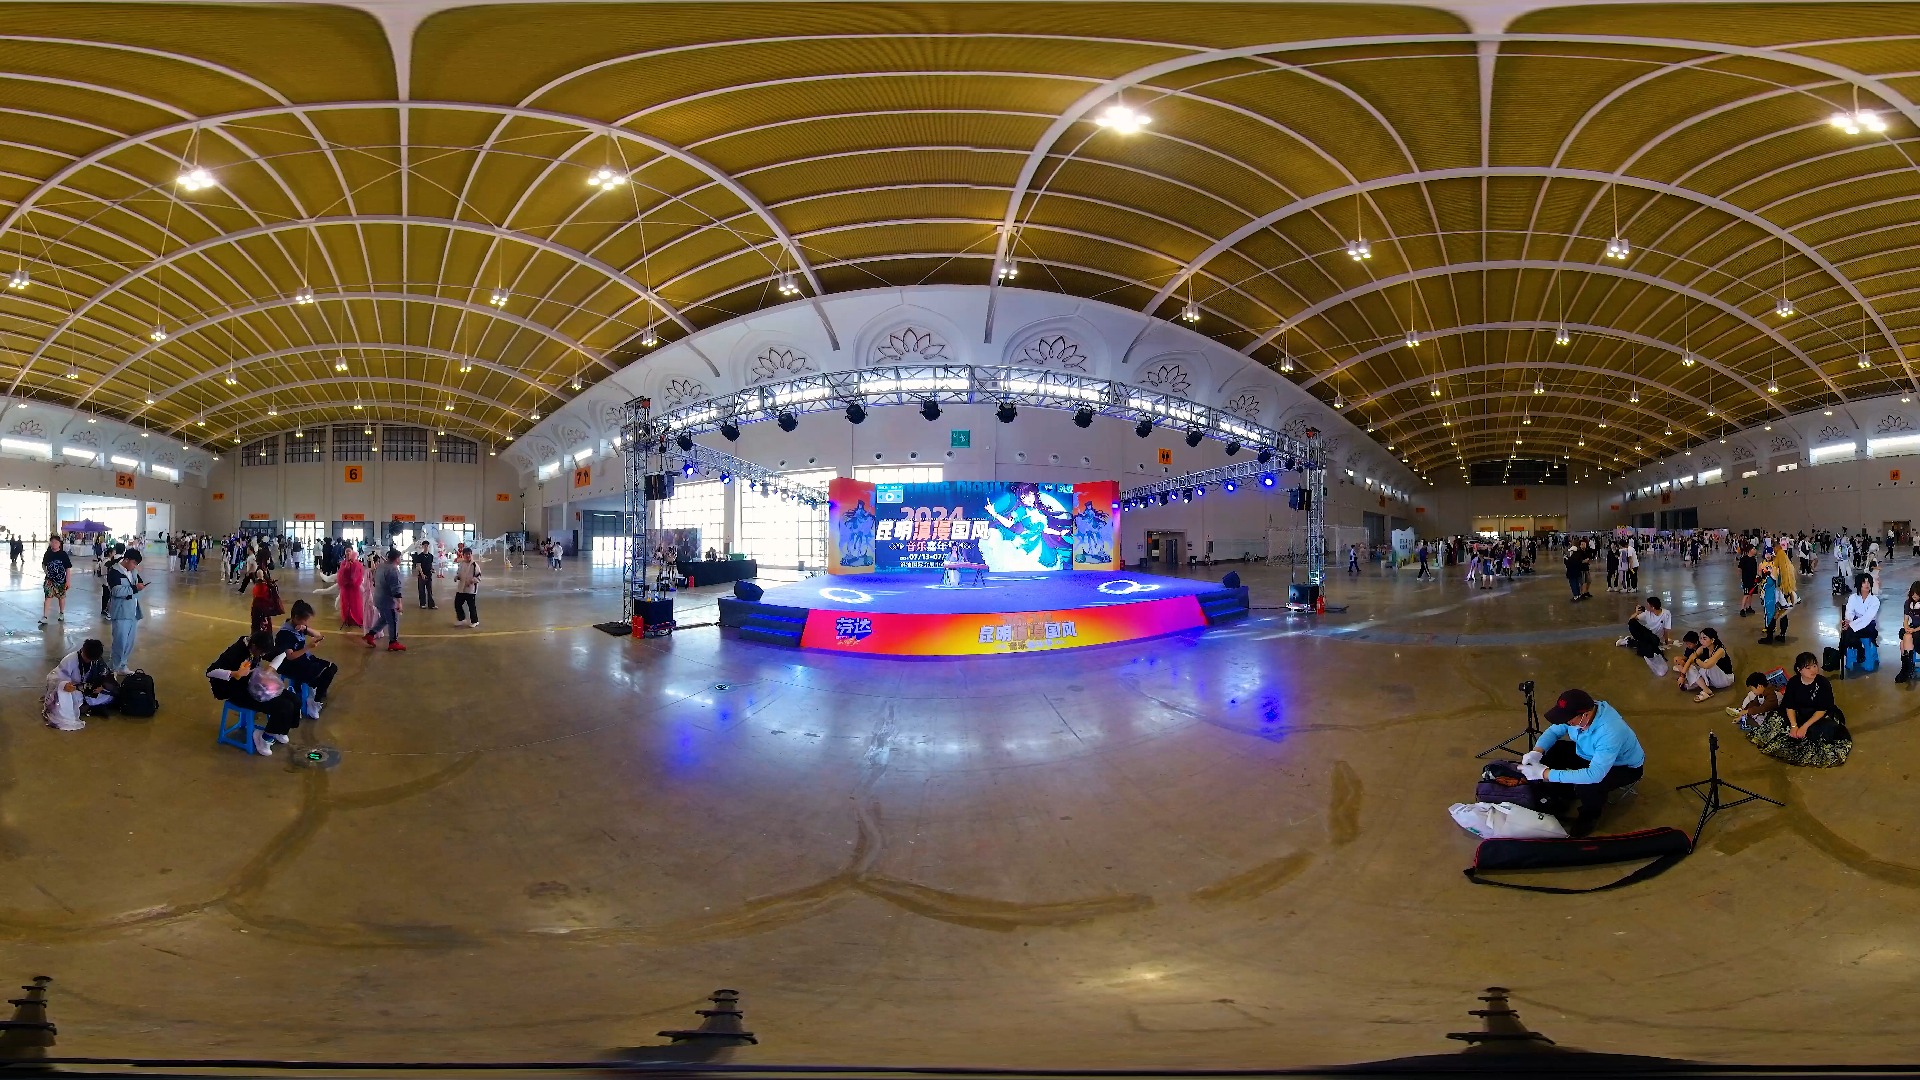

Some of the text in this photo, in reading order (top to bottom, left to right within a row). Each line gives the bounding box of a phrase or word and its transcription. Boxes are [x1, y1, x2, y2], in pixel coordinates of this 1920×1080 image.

[350, 469, 357, 480] 6
[119, 475, 126, 486] 5
[901, 507, 963, 521] 2024
[906, 541, 953, 552] 音乐嘉年
[836, 617, 872, 635] 芬达
